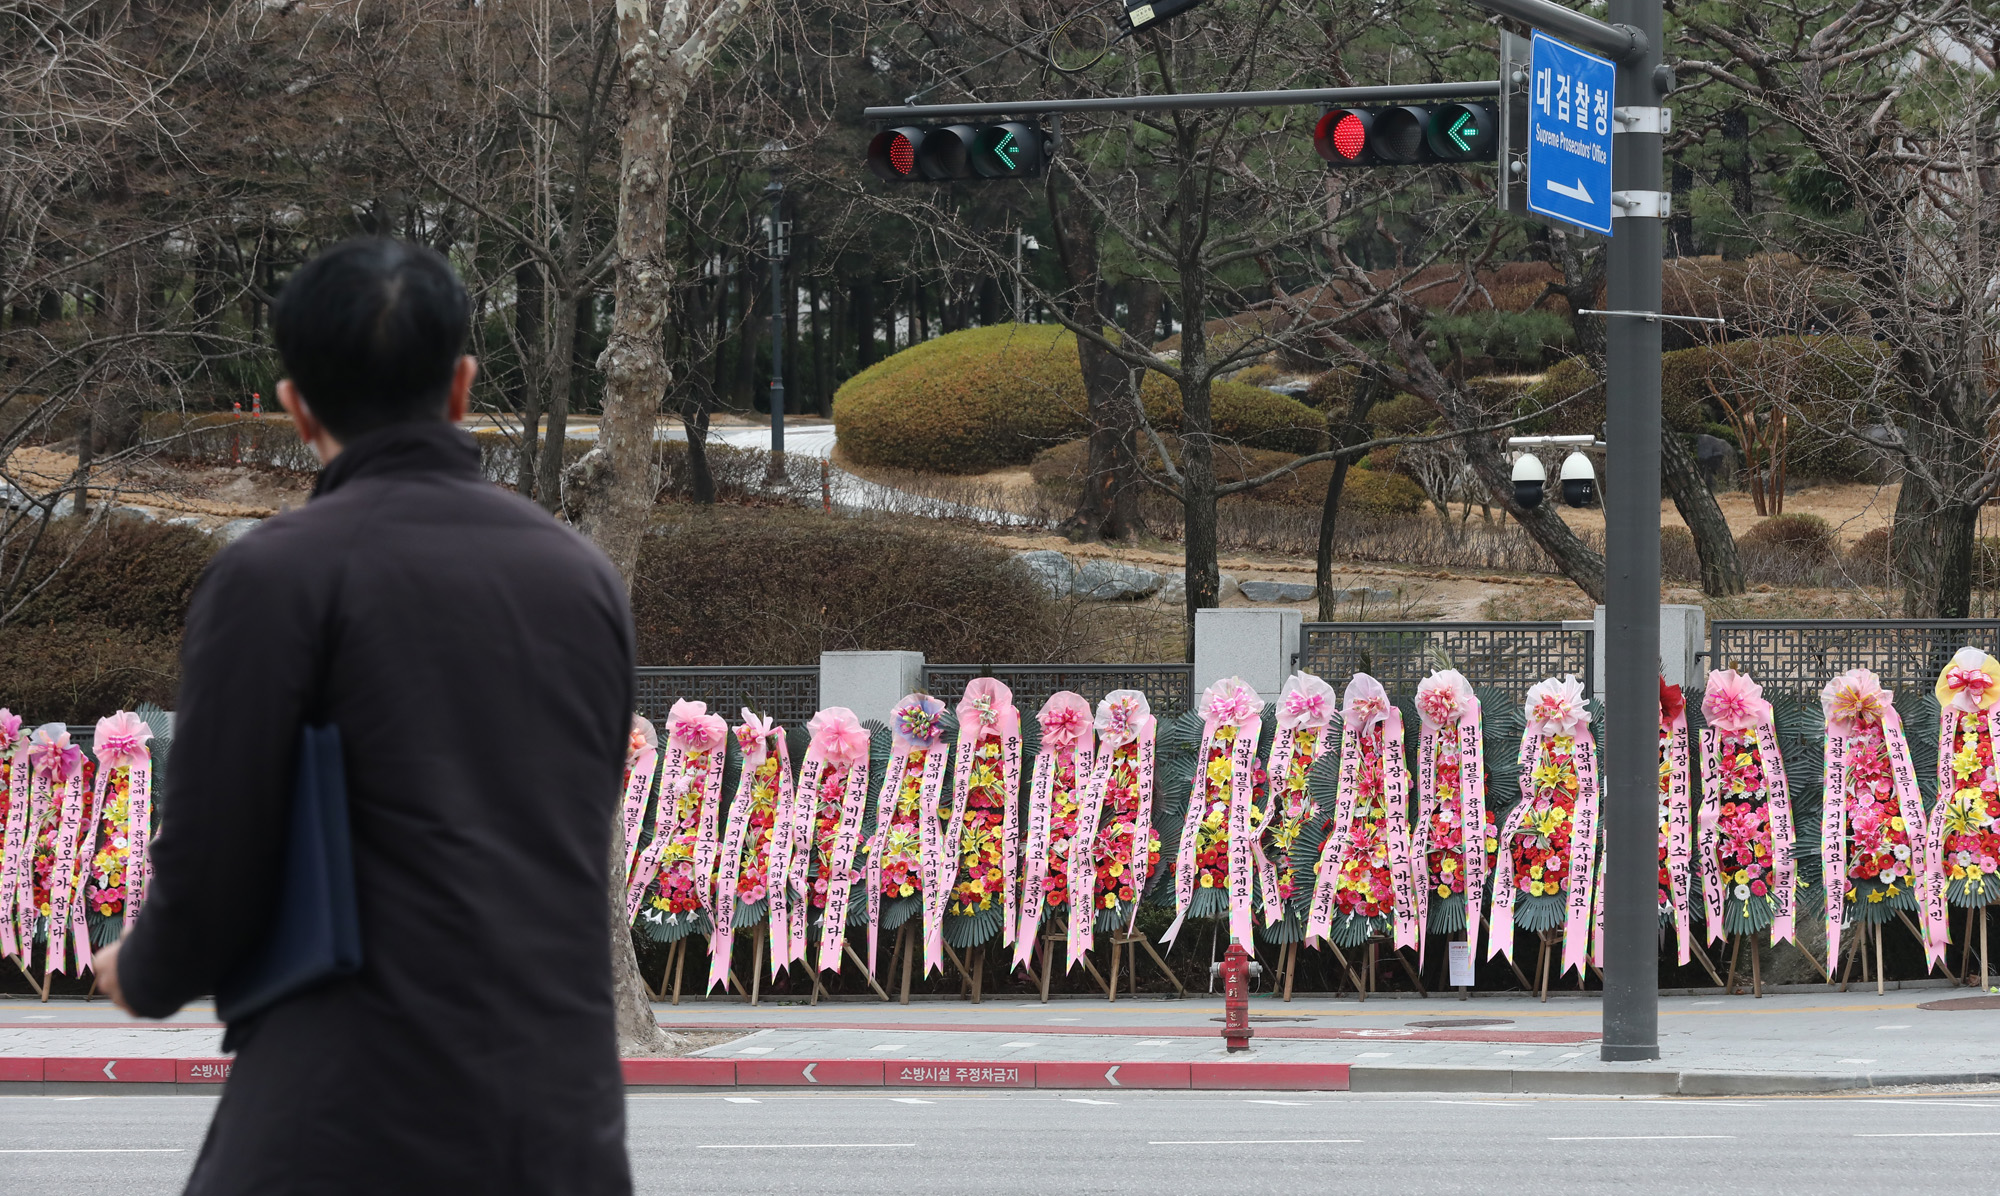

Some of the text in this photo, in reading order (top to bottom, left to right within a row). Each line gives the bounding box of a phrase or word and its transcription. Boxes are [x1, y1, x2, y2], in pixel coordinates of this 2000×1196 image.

[1536, 67, 1608, 136] 대검찰청
[1535, 123, 1607, 165] Supreme Prosecutors' Office
[1235, 739, 1252, 768] 법앞에
[1275, 729, 1291, 760] 김오수
[1673, 727, 1688, 767] 본부장
[1759, 723, 1777, 751] 역사에
[666, 749, 682, 778] 김오수
[802, 760, 819, 791] 법대로
[926, 753, 943, 780] 법앞에
[957, 742, 971, 775] 김오수
[1576, 742, 1593, 773] 법앞에
[923, 784, 937, 812] 평등!
[1234, 771, 1249, 801] 평등!
[1580, 777, 1596, 806] 평등!
[1672, 771, 1686, 796] 비리
[1462, 725, 1484, 911] 법앞에 평등! 윤석열 수사해주세요!
[1672, 802, 1688, 827] 수사
[1701, 728, 1720, 917] 김오수 총장님
[696, 815, 714, 867] 김오수가
[1386, 740, 1414, 933] 본부장 비리 수사 기소 바랍니다!
[1671, 833, 1687, 857] 기소
[1826, 811, 1843, 875] 지켜주세요!
[56, 835, 74, 889] 김오수가
[722, 829, 740, 890] 지켜주세요!
[827, 764, 867, 950] 본부장 비리 수사 기소 바랍니다!
[1233, 835, 1249, 908] 수사해주세요!
[770, 852, 787, 921] 수사해주세요!
[1570, 841, 1591, 920] 수사해주세요!
[627, 881, 646, 920] 촛불시
[53, 896, 67, 954] 잡는다!
[900, 1067, 1019, 1082] 소방시설 주정차금지
